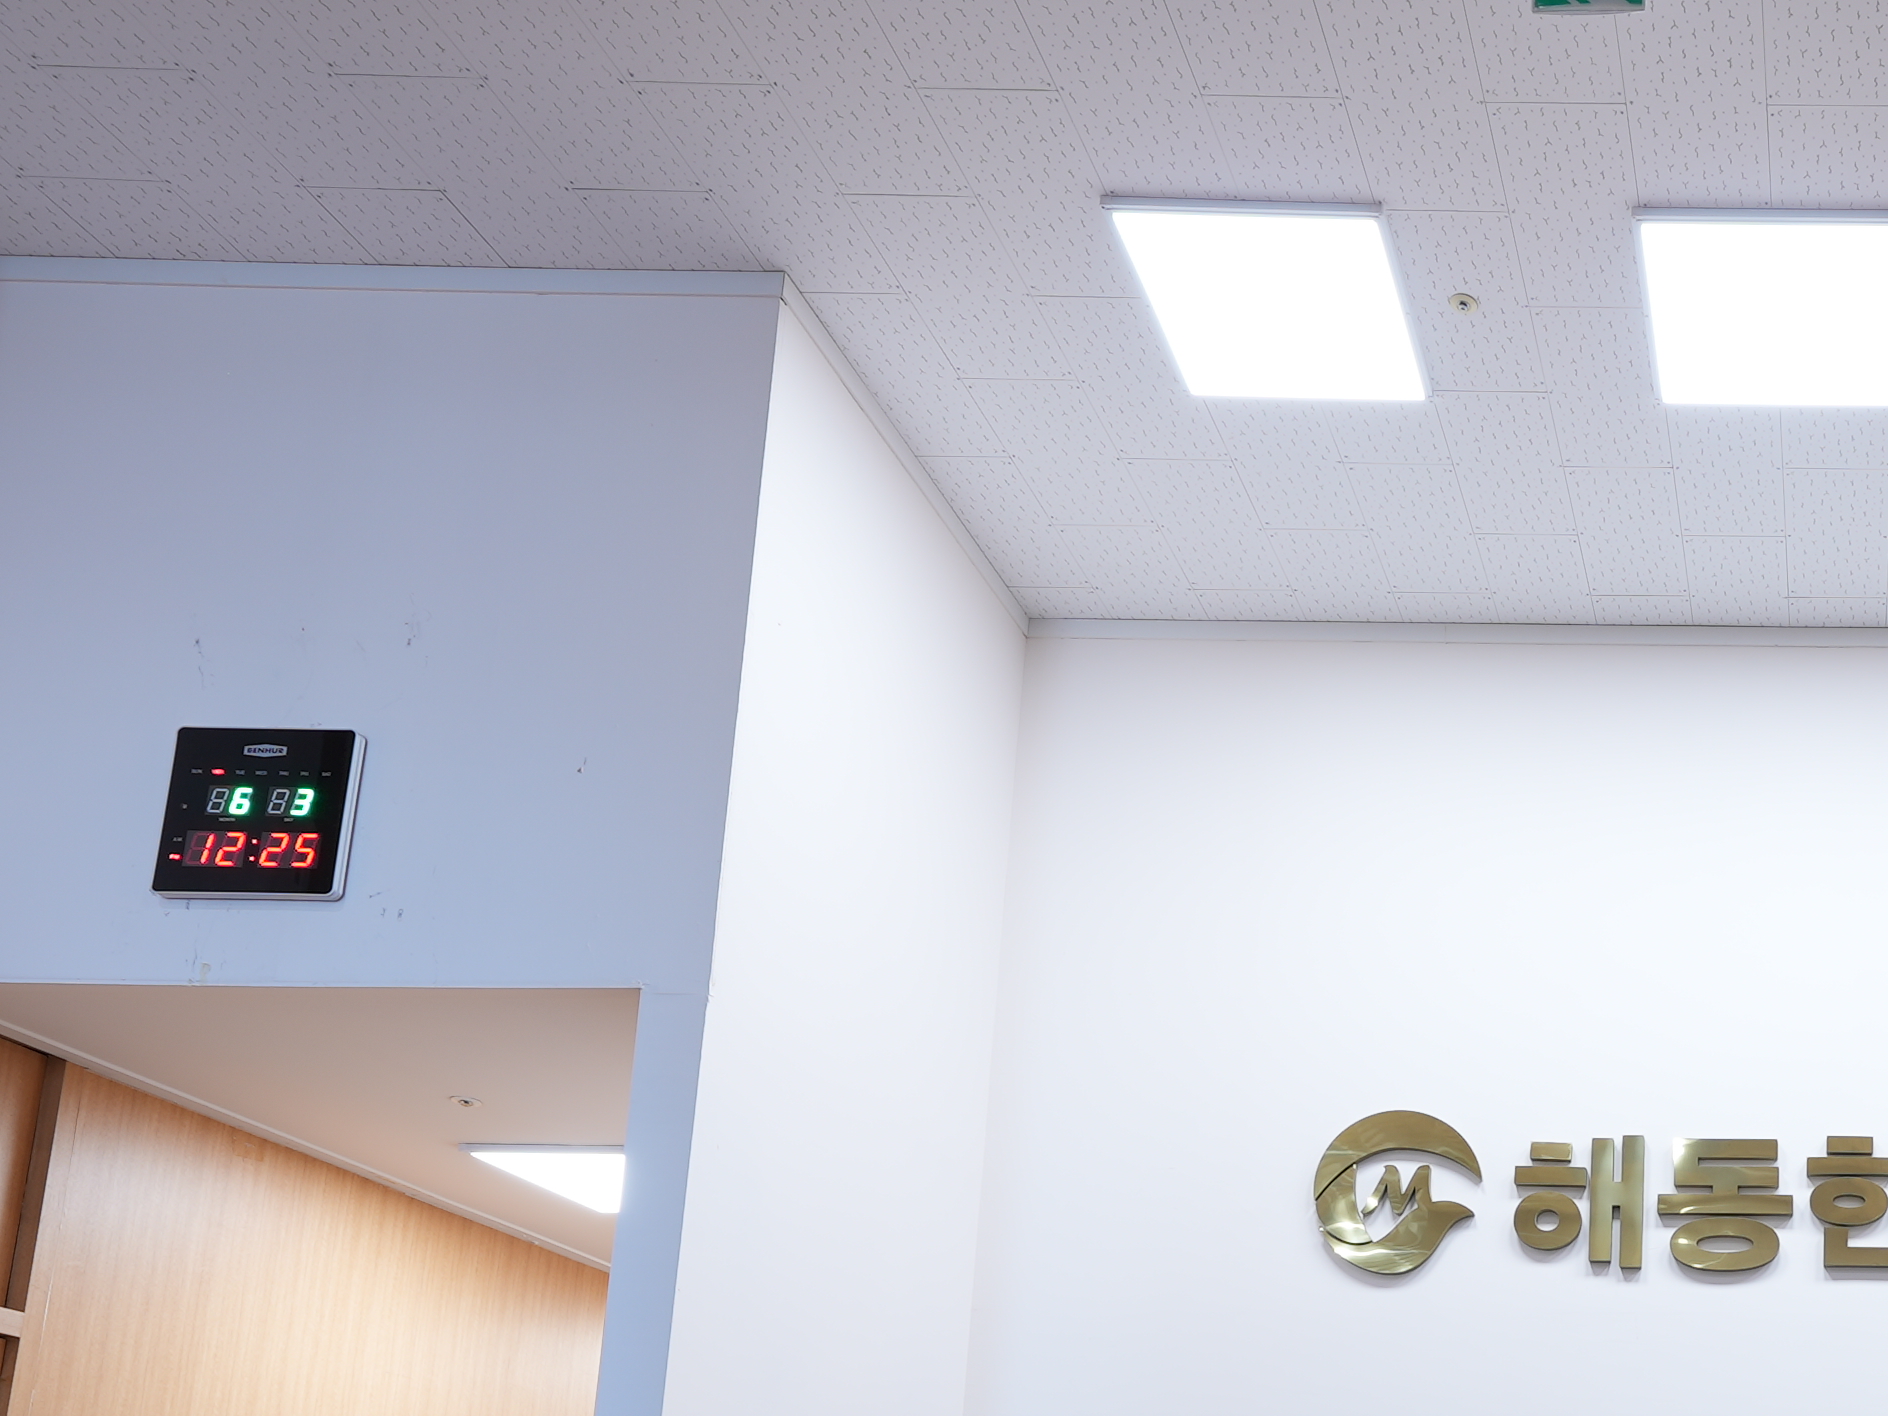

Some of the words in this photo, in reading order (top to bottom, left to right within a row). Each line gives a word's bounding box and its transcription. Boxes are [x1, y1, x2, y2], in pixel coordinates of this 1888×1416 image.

[229, 787, 253, 815] 6
[290, 788, 314, 816] 3
[200, 832, 319, 867] 12:25
